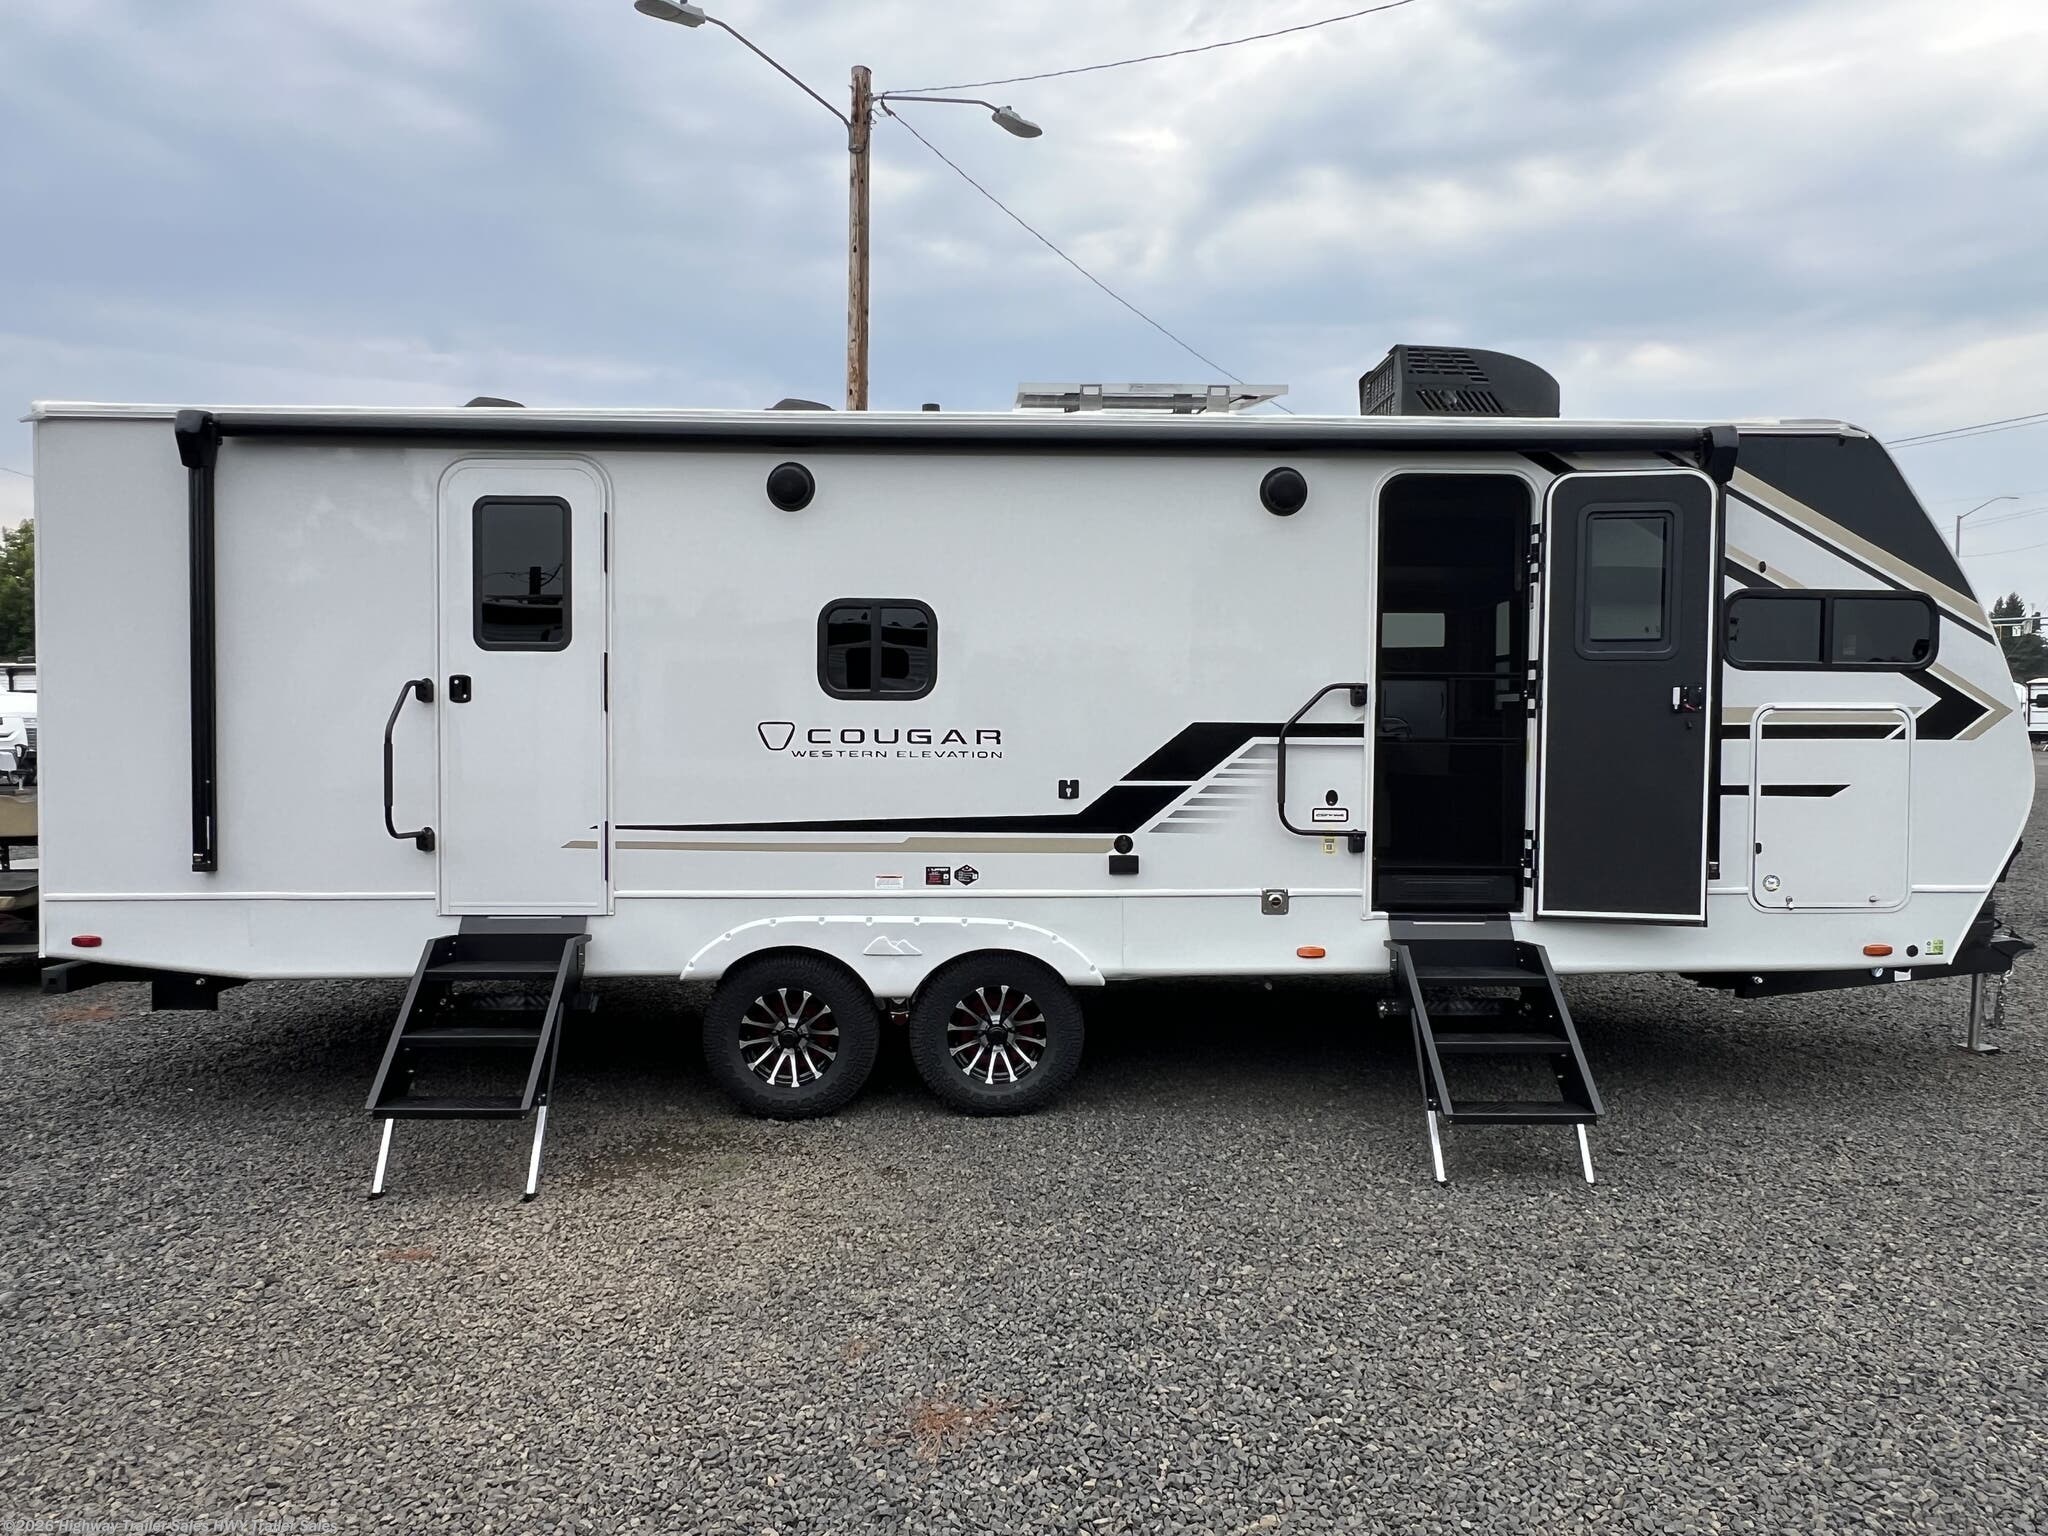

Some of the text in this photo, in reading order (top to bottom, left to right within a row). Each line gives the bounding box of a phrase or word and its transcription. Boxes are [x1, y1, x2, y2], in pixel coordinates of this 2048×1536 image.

[807, 728, 1001, 745] COUGAR
[791, 750, 1003, 759] WESTERN ELEVATION
